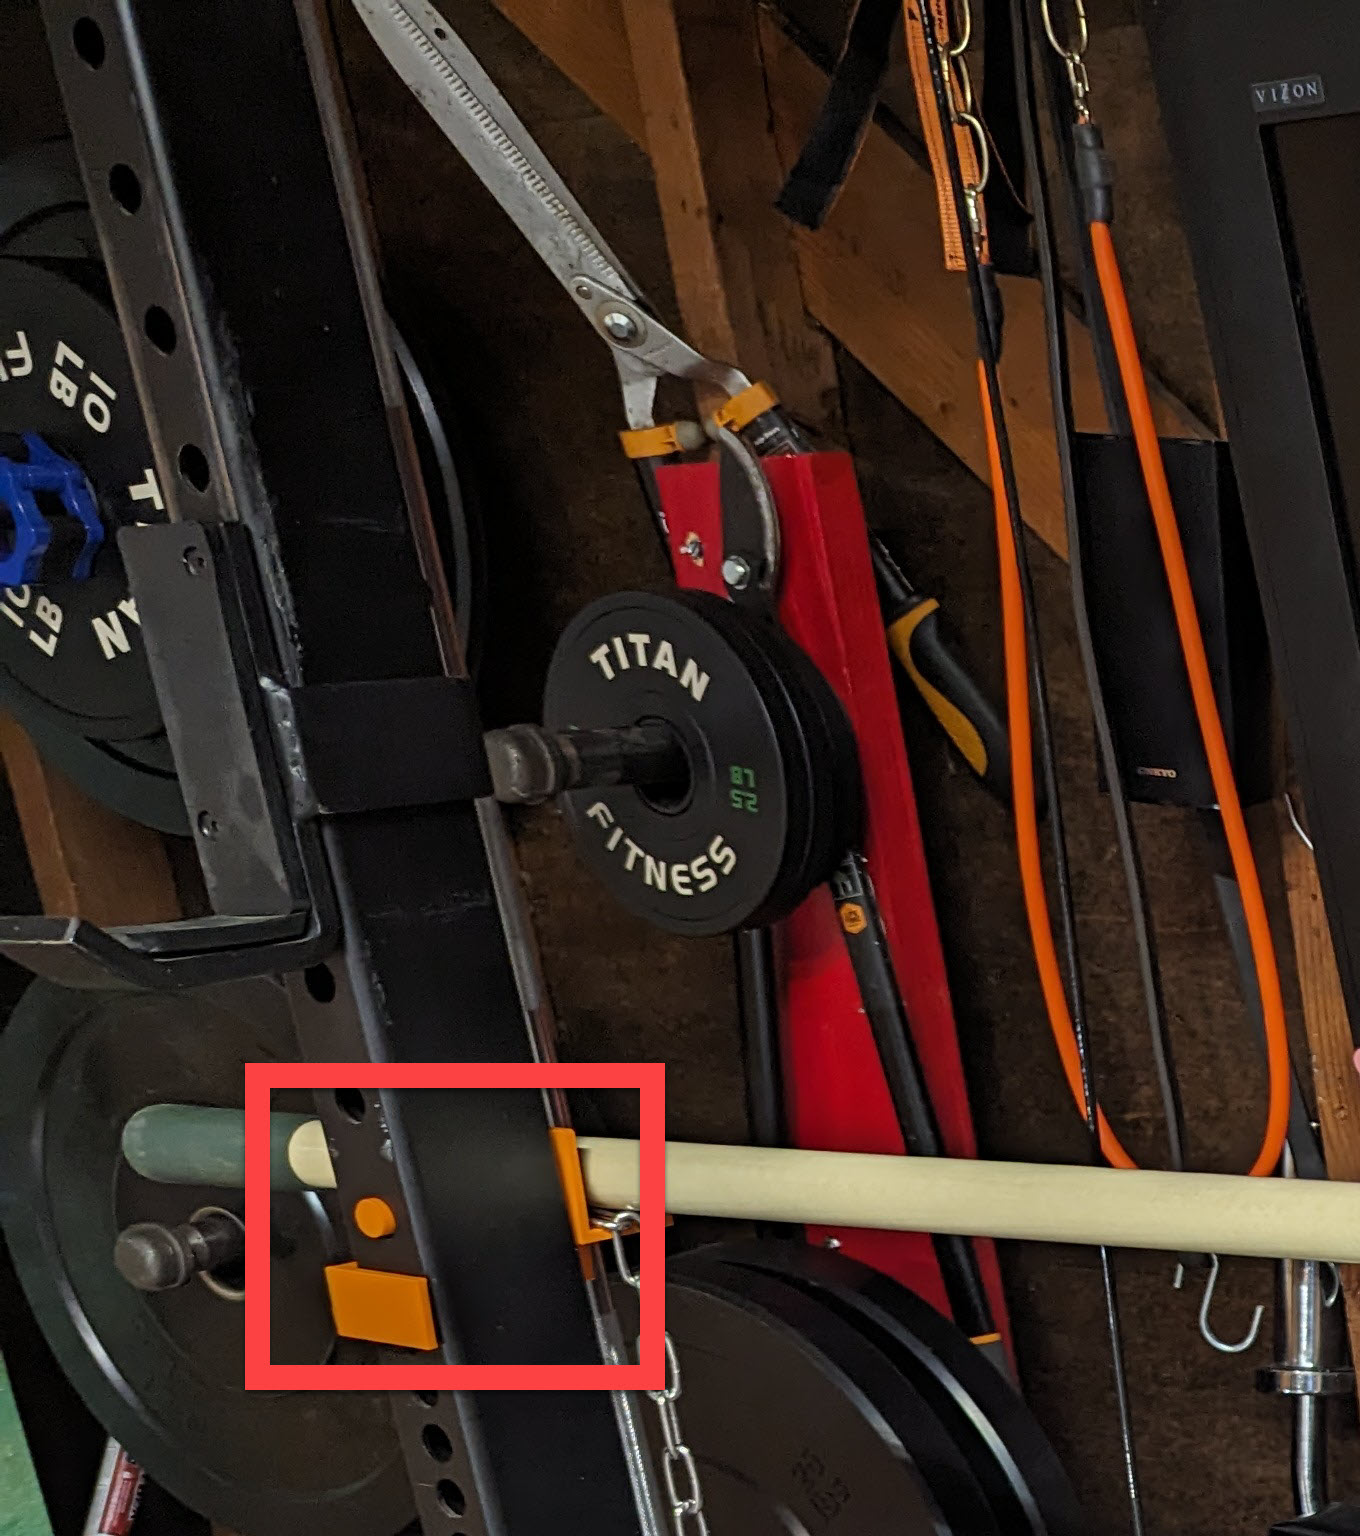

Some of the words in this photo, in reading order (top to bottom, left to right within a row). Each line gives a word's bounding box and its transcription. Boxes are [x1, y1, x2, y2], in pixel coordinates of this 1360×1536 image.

[49, 340, 85, 409] LB
[29, 595, 64, 657] LB
[589, 633, 711, 702] TITAN
[586, 801, 738, 896] FITNESS
